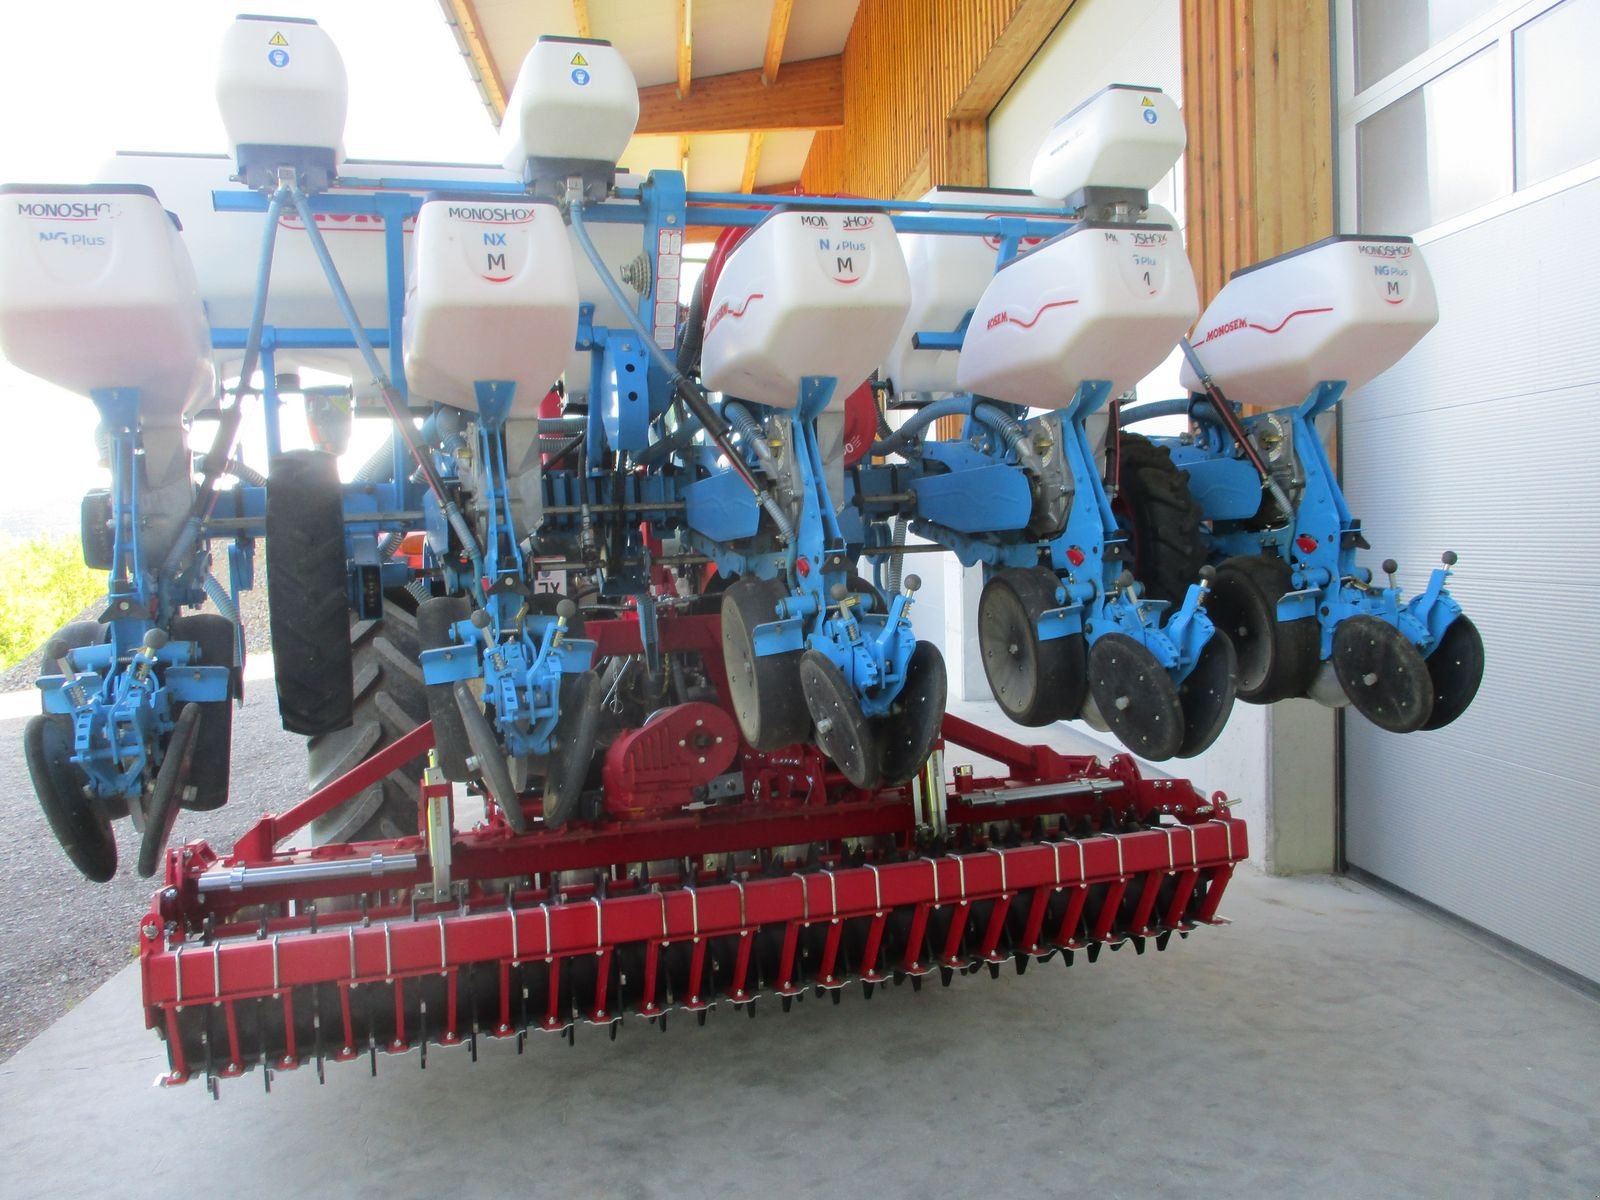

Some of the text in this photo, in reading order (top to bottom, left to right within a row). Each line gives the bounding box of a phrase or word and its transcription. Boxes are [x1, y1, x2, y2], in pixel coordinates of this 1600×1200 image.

[448, 207, 535, 221] MONOSHOX
[71, 234, 105, 246] Plus
[483, 232, 507, 246] NX
[487, 253, 506, 271] M
[837, 257, 854, 273] M
[1387, 281, 1400, 295] M
[1205, 318, 1249, 342] MONOSEM
